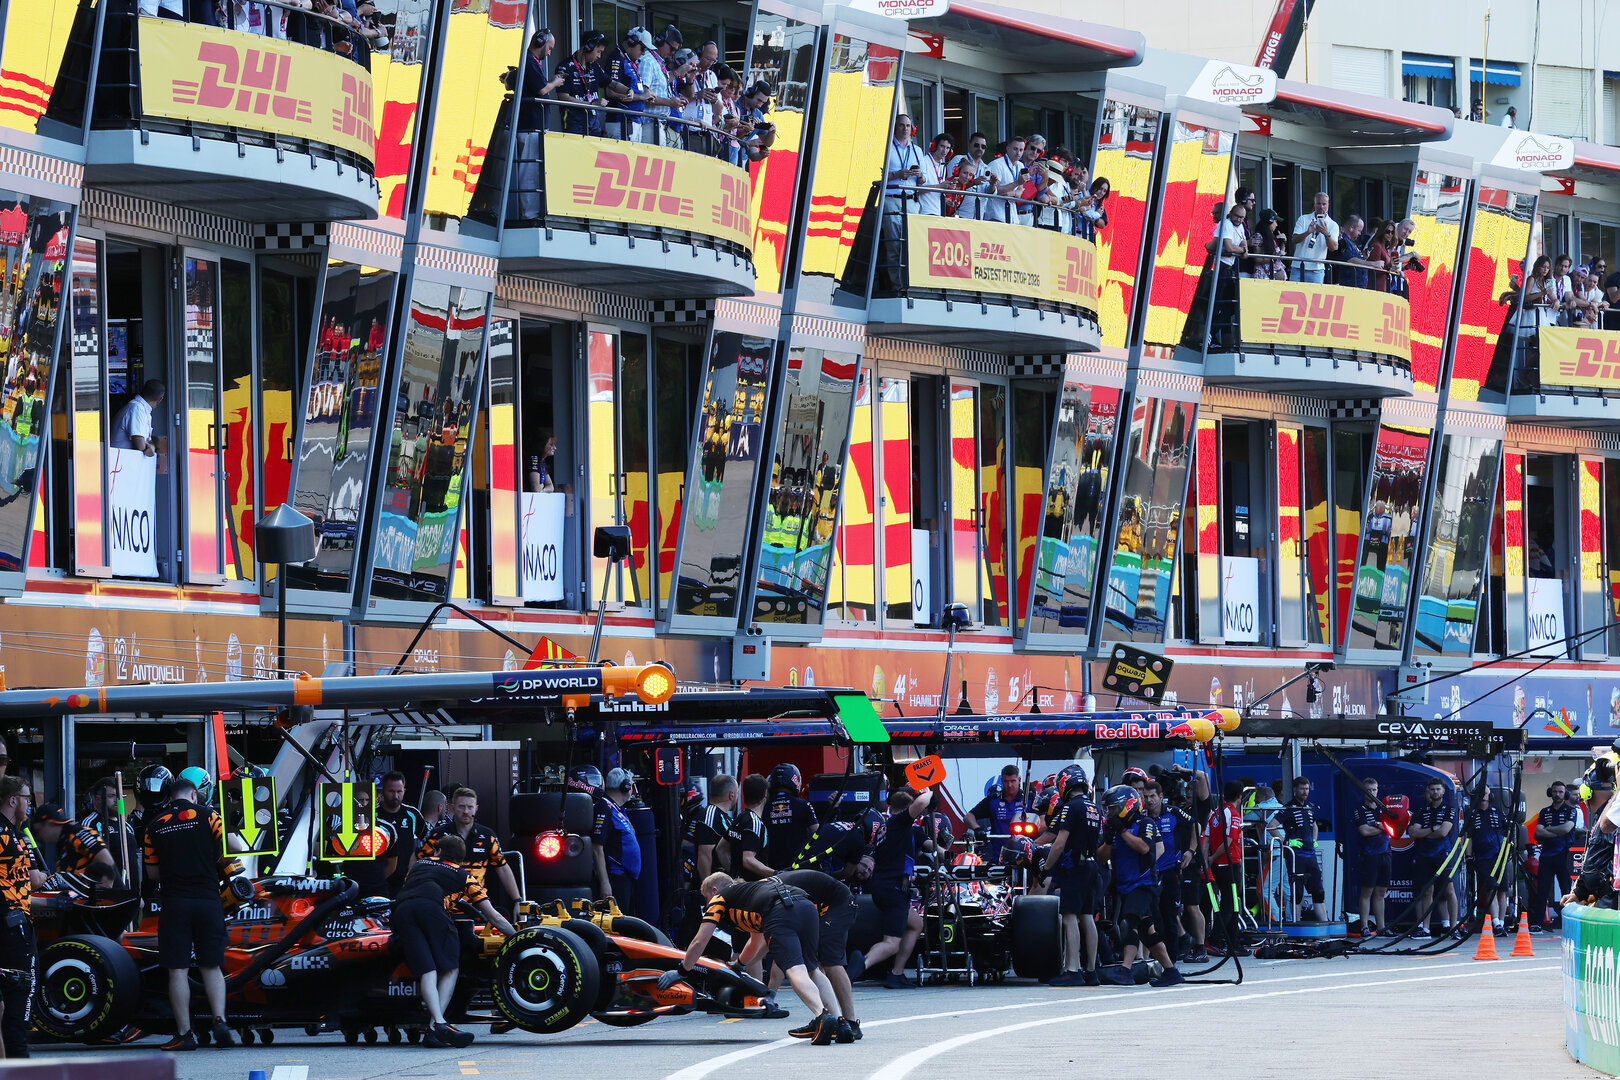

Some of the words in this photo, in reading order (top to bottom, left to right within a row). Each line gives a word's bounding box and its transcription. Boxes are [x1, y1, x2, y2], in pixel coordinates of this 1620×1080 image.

[878, 0, 934, 8] MONACO
[885, 7, 927, 16] CIRCUIT
[197, 41, 299, 121] DHL
[1212, 87, 1263, 95] MONACO
[1219, 95, 1257, 103] CIRCUIT
[341, 72, 373, 149] DHL
[1516, 154, 1562, 162] MONACO
[593, 151, 681, 216] DHL
[719, 173, 751, 238] DHL
[979, 242, 1007, 262] DHL
[974, 266, 1001, 281] FASTEST
[1002, 268, 1013, 282] PIT
[1013, 270, 1027, 285] STOP
[1027, 273, 1041, 287] 2026
[1066, 246, 1097, 301] DHL
[1277, 291, 1349, 339] DHL
[1382, 302, 1408, 350] DHL
[1575, 337, 1620, 380] DH
[111, 505, 150, 554] NACO
[1224, 601, 1253, 633] NACO
[413, 649, 439, 663] ORACLE
[131, 665, 185, 682] ANTONELLI
[1117, 664, 1146, 679] brembo
[522, 679, 543, 690] DP
[544, 676, 598, 689] WORLD
[893, 674, 906, 701] 44
[1008, 676, 1020, 703] 16
[1333, 685, 1342, 715] 23
[1344, 704, 1366, 716] ALBON
[1429, 727, 1480, 735] LOGISTICS
[913, 758, 933, 771] BRAKES
[339, 941, 380, 952] VELO
[608, 962, 622, 972] FIA
[388, 981, 417, 996] intel
[656, 989, 688, 1001] workday
